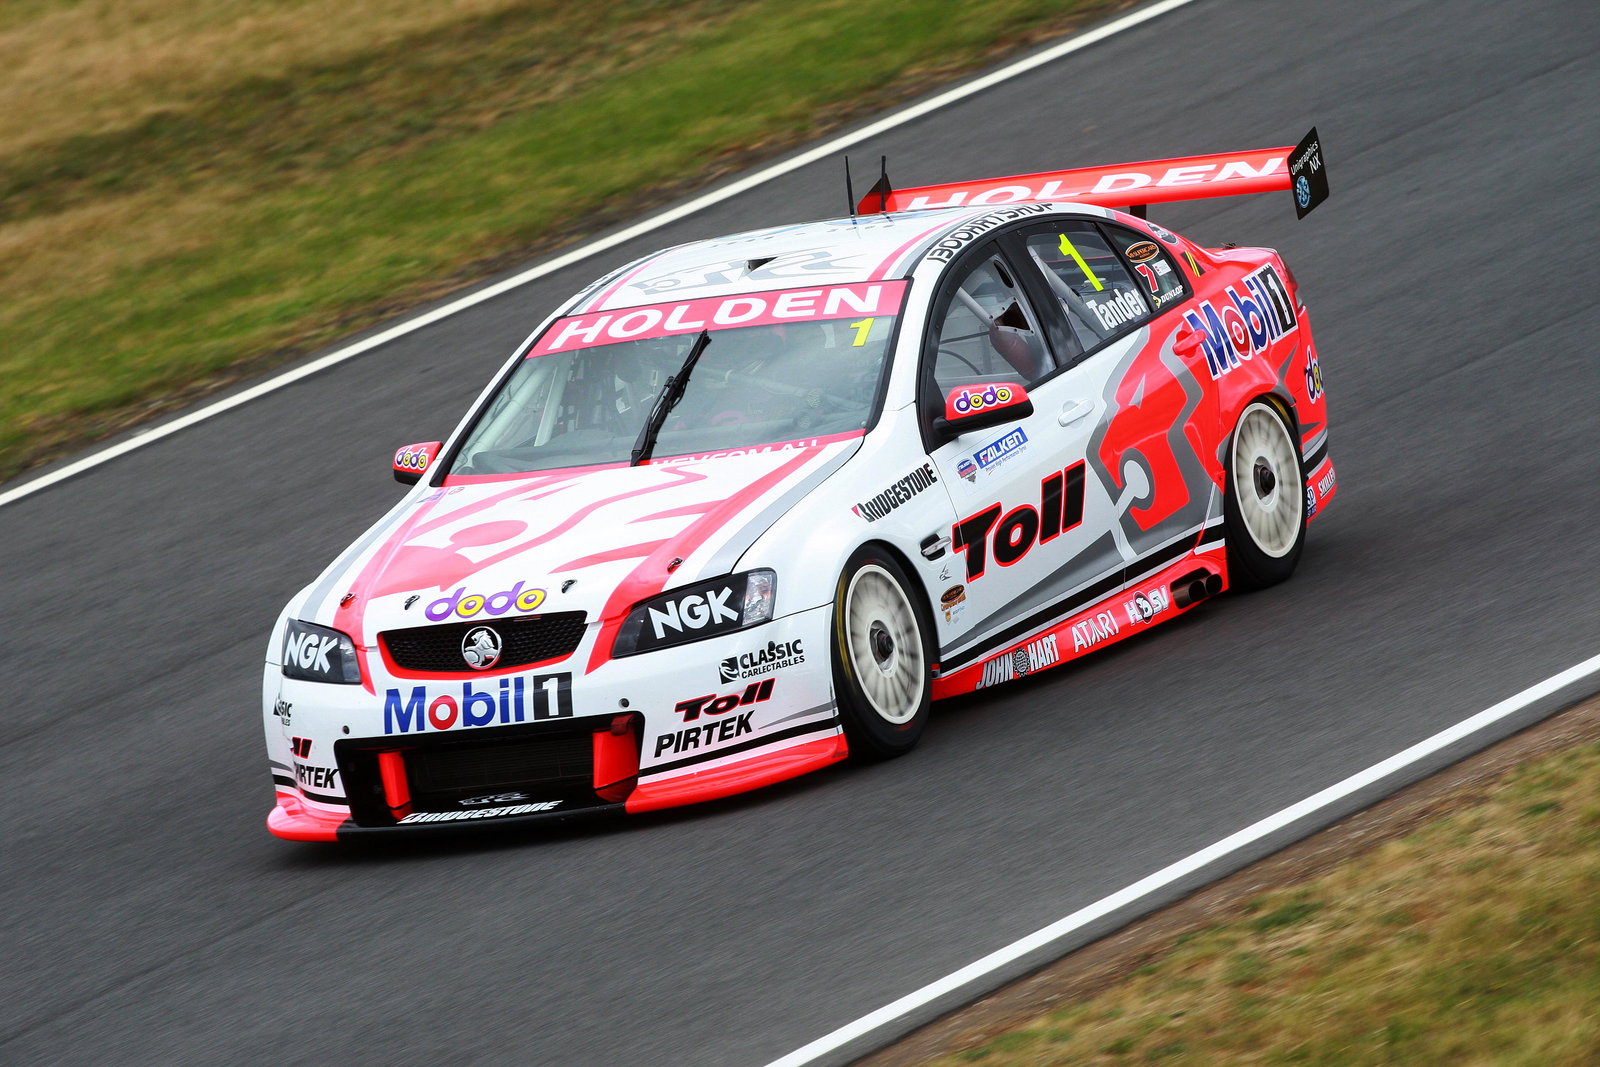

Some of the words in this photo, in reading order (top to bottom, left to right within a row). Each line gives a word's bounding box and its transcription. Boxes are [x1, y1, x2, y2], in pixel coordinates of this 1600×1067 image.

[1290, 140, 1319, 176] Unigraphics
[1309, 152, 1322, 174] NX
[906, 156, 1285, 209] HOLDEN
[1057, 233, 1104, 292] 1
[1087, 287, 1147, 331] Tander
[1161, 285, 1184, 304] DUNLOP
[548, 286, 884, 351] HOLDEN
[849, 317, 875, 348] 1
[1184, 269, 1281, 380] Mobil
[1264, 267, 1296, 332] 1
[953, 384, 1012, 414] dodo
[395, 446, 429, 470] dodo
[979, 431, 1024, 466] FALKEN
[852, 462, 938, 522] BRIDGESTONE
[951, 458, 1086, 584] Toll
[425, 580, 548, 622] dodo
[648, 585, 740, 641] NGK
[284, 632, 340, 674] NGK
[1072, 609, 1120, 654] ATARI
[739, 639, 804, 670] CLASSIC
[741, 656, 806, 679] CARLECTABLES
[975, 652, 1014, 690] JOHN
[1028, 633, 1060, 672] HART
[384, 677, 525, 735] Mobil
[675, 678, 776, 722] Toll
[654, 710, 755, 758] PIRTEK
[396, 800, 564, 825] BRIDGESTONE
